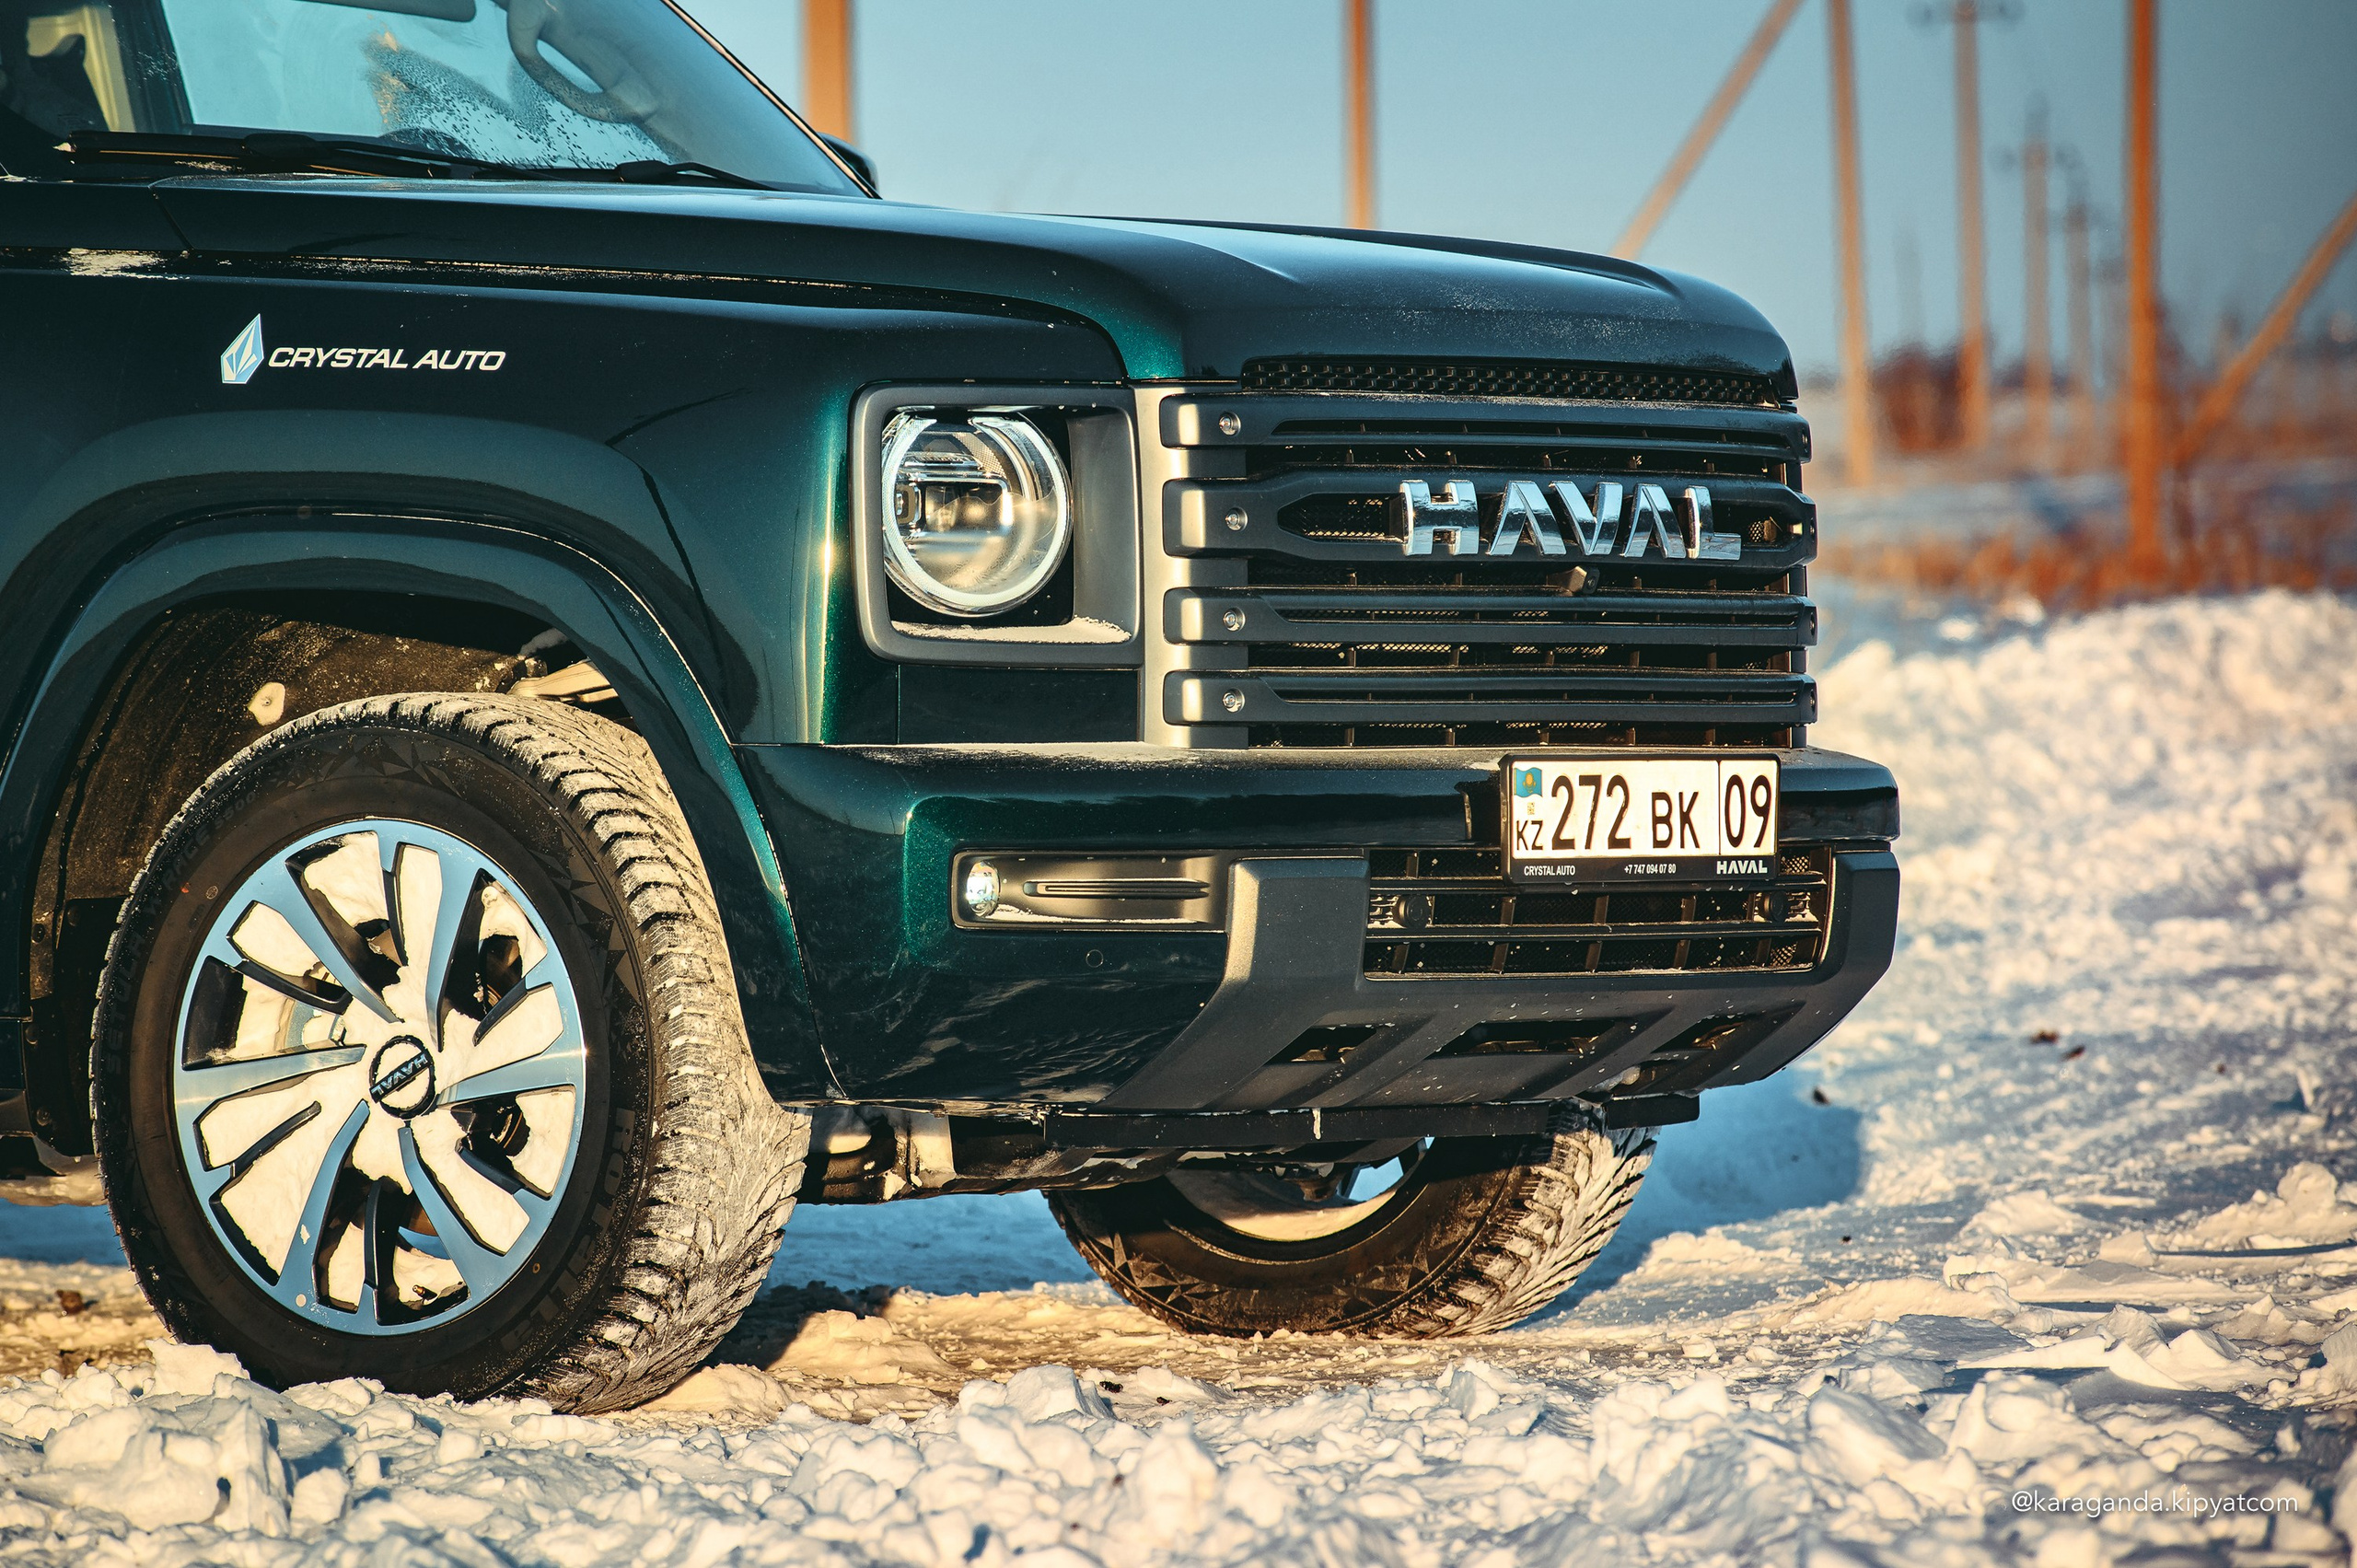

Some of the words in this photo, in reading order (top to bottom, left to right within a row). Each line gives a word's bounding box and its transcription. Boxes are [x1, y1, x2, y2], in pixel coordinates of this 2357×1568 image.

[268, 347, 408, 368] CRYSTAL
[412, 350, 505, 371] AUTO
[1399, 479, 1741, 560] HAVAL
[1550, 774, 1631, 850] 272
[1652, 791, 1701, 849] BK
[1724, 773, 1772, 849] 09
[1515, 820, 1544, 851] KZ
[1524, 865, 1555, 876] CRYSTAL
[1556, 865, 1576, 876] AUTO
[1624, 865, 1633, 875] +7
[1634, 864, 1645, 874] 747
[1646, 864, 1658, 874] 094
[1659, 864, 1667, 874] 07
[1716, 860, 1768, 875] HAVAL
[371, 1053, 428, 1095] HAVAL
